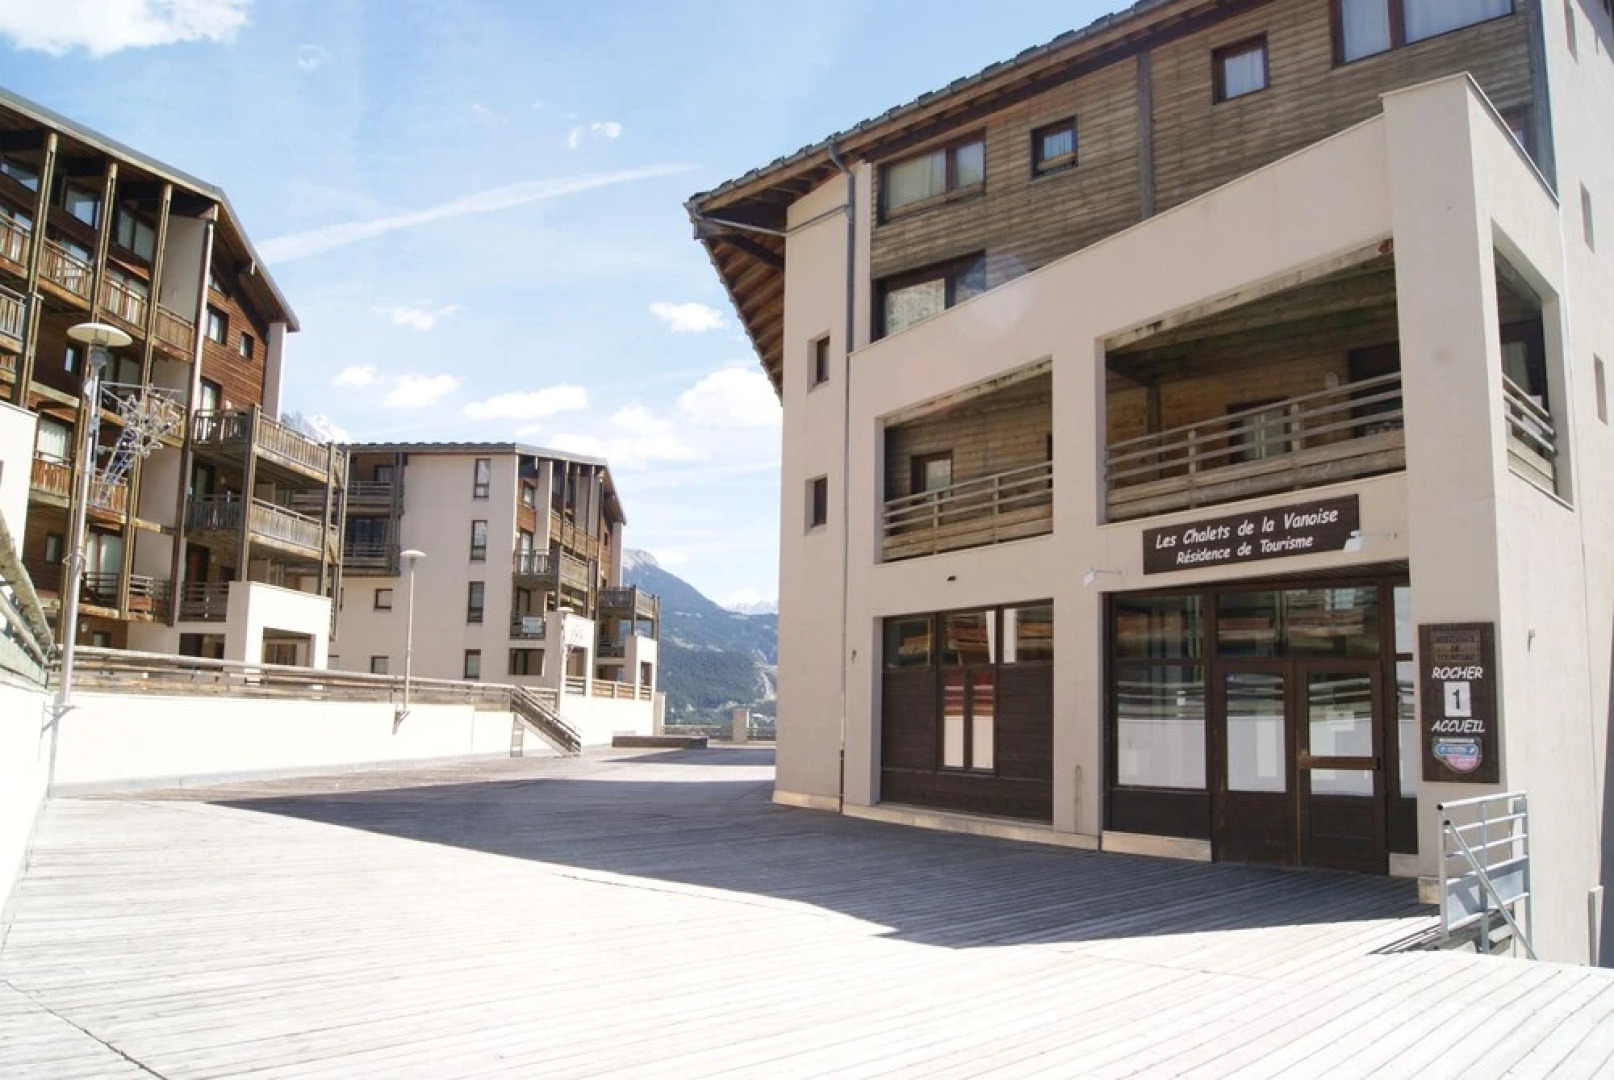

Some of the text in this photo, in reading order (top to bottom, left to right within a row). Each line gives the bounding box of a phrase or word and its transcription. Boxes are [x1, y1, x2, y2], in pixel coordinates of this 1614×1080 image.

[1155, 508, 1339, 549] Les Chalets de la Vanoise
[1176, 535, 1314, 565] Résidence de Tourisme
[1431, 666, 1483, 679] ROCHER
[1452, 688, 1460, 710] 1
[1431, 719, 1486, 733] ACCUEIL
